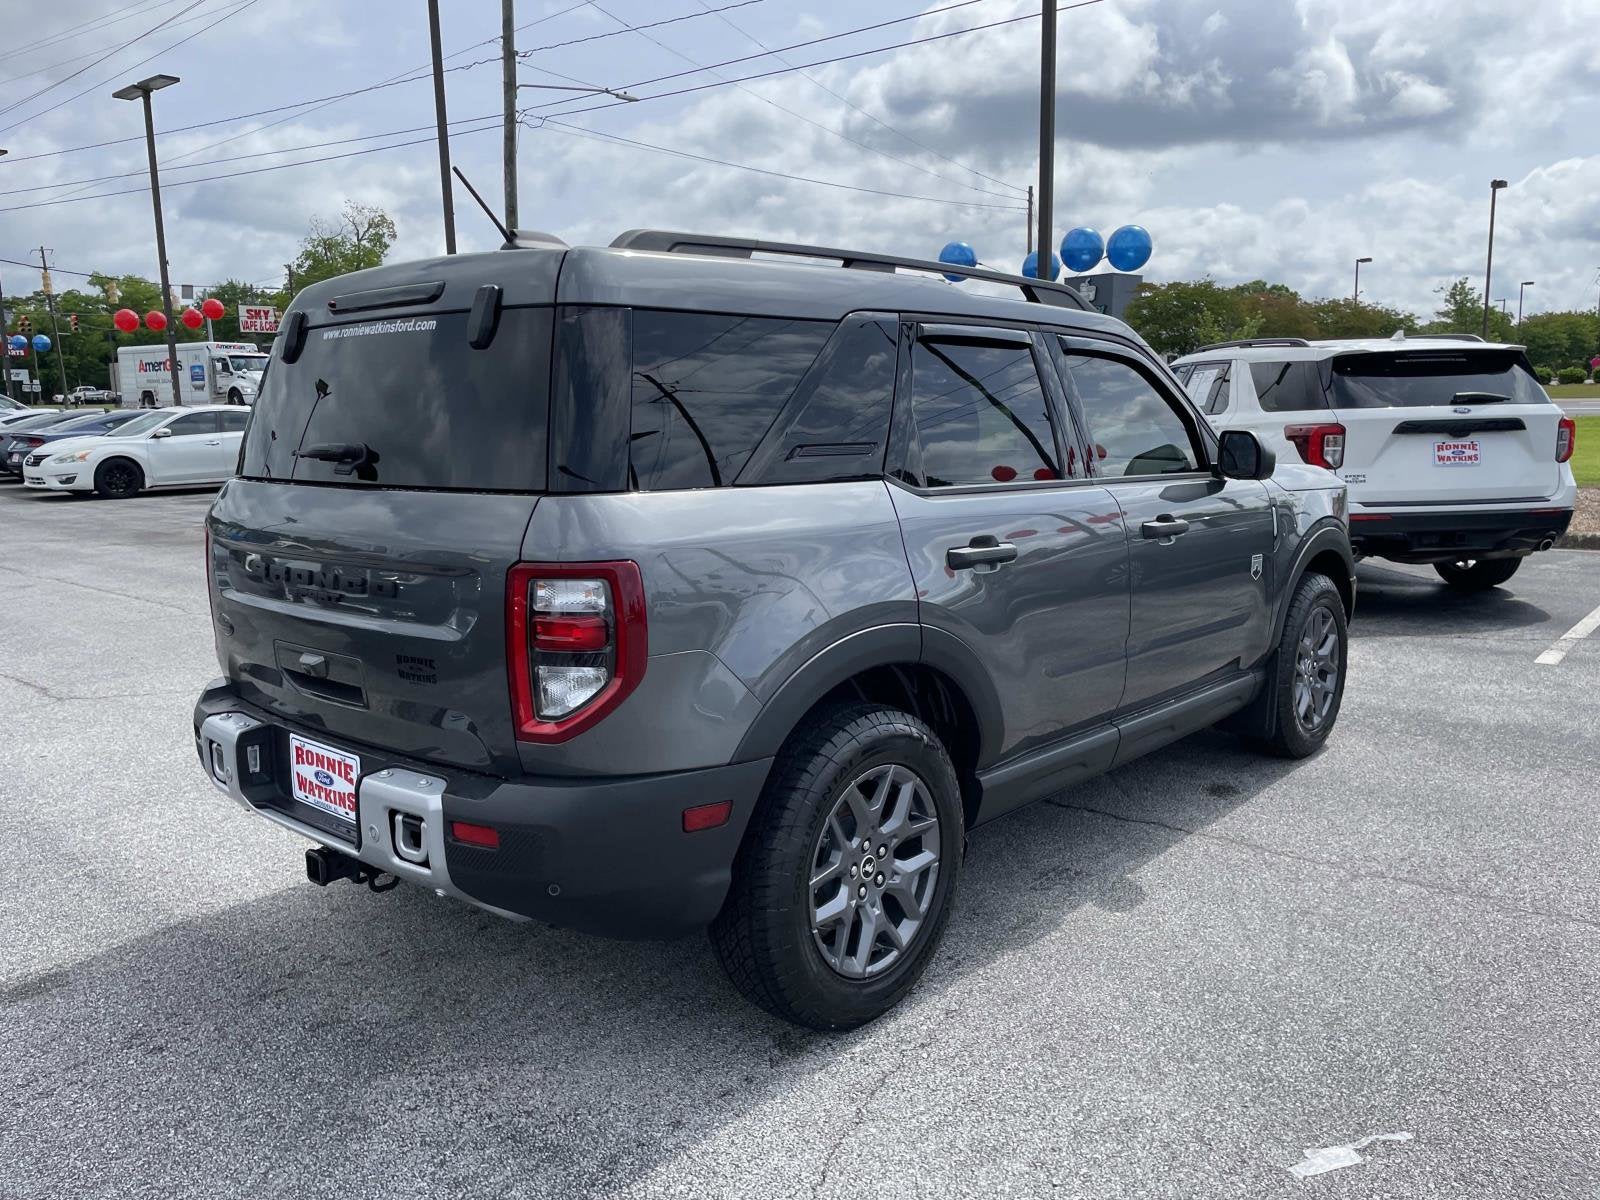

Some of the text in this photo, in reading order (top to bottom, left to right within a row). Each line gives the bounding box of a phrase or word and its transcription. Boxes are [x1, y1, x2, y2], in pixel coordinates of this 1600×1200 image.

[242, 321, 258, 331] VAPE
[323, 319, 437, 340] www.ronniewatkinsford.com
[138, 359, 183, 373] AmeriGs
[1437, 443, 1478, 452] RONNIE
[1437, 454, 1479, 462] WATKINS
[295, 746, 354, 786] RONNIE
[296, 771, 356, 812] WATKINS
